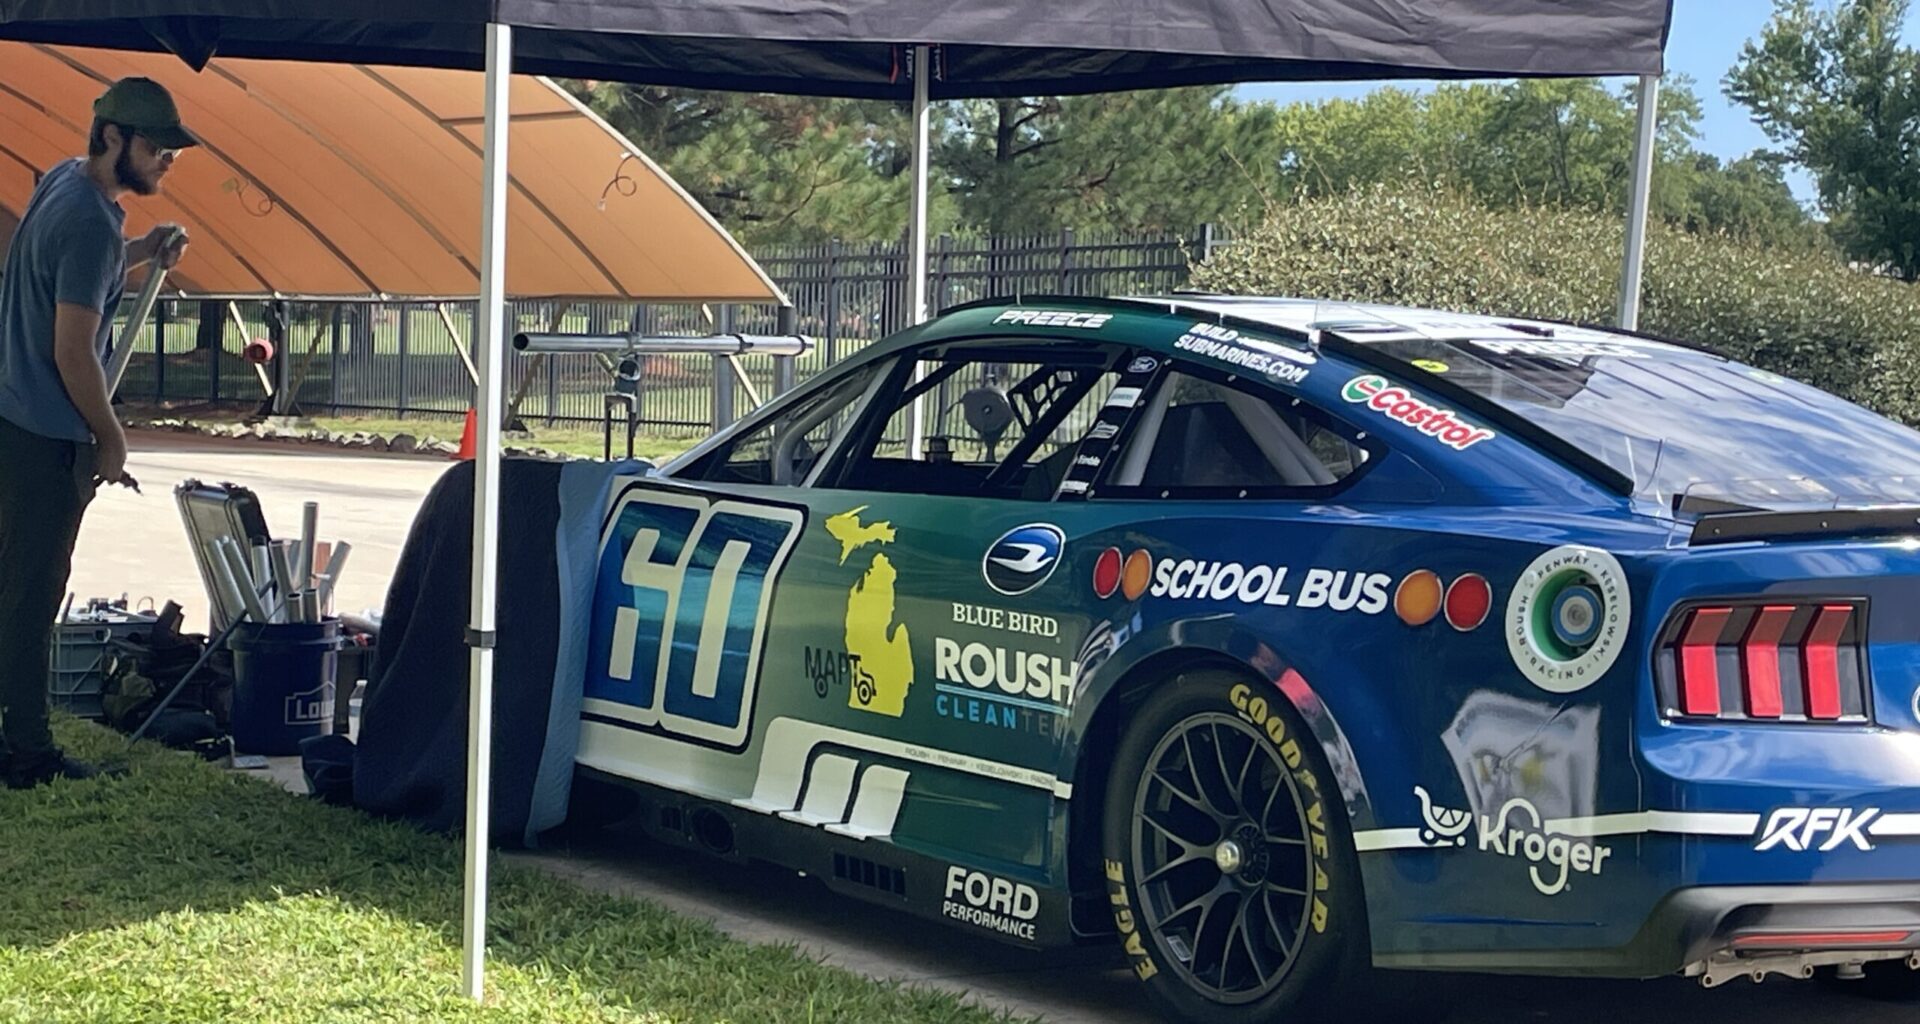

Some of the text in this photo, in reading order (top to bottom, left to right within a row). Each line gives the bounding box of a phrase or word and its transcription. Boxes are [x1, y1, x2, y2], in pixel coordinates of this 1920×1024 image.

[993, 310, 1114, 328] PREECE
[1189, 322, 1239, 342] BUILD
[1174, 334, 1309, 383] SUBMARINES.COM
[1370, 386, 1495, 449] Castrol
[1150, 558, 1392, 614] SCHOOL BUS
[581, 492, 801, 740] 60
[952, 603, 1058, 637] BLUE BIRD
[1516, 595, 1529, 647] ROUSH
[1530, 657, 1584, 680] RACING
[935, 637, 1079, 705] ROUSH
[1230, 684, 1328, 933] GOODYEAR
[1754, 808, 1879, 851] RFK
[1478, 798, 1611, 895] Kroger
[943, 901, 1036, 940] PERFORMANCE
[945, 866, 1040, 920] FORD
[1105, 858, 1159, 982] EAGLE
